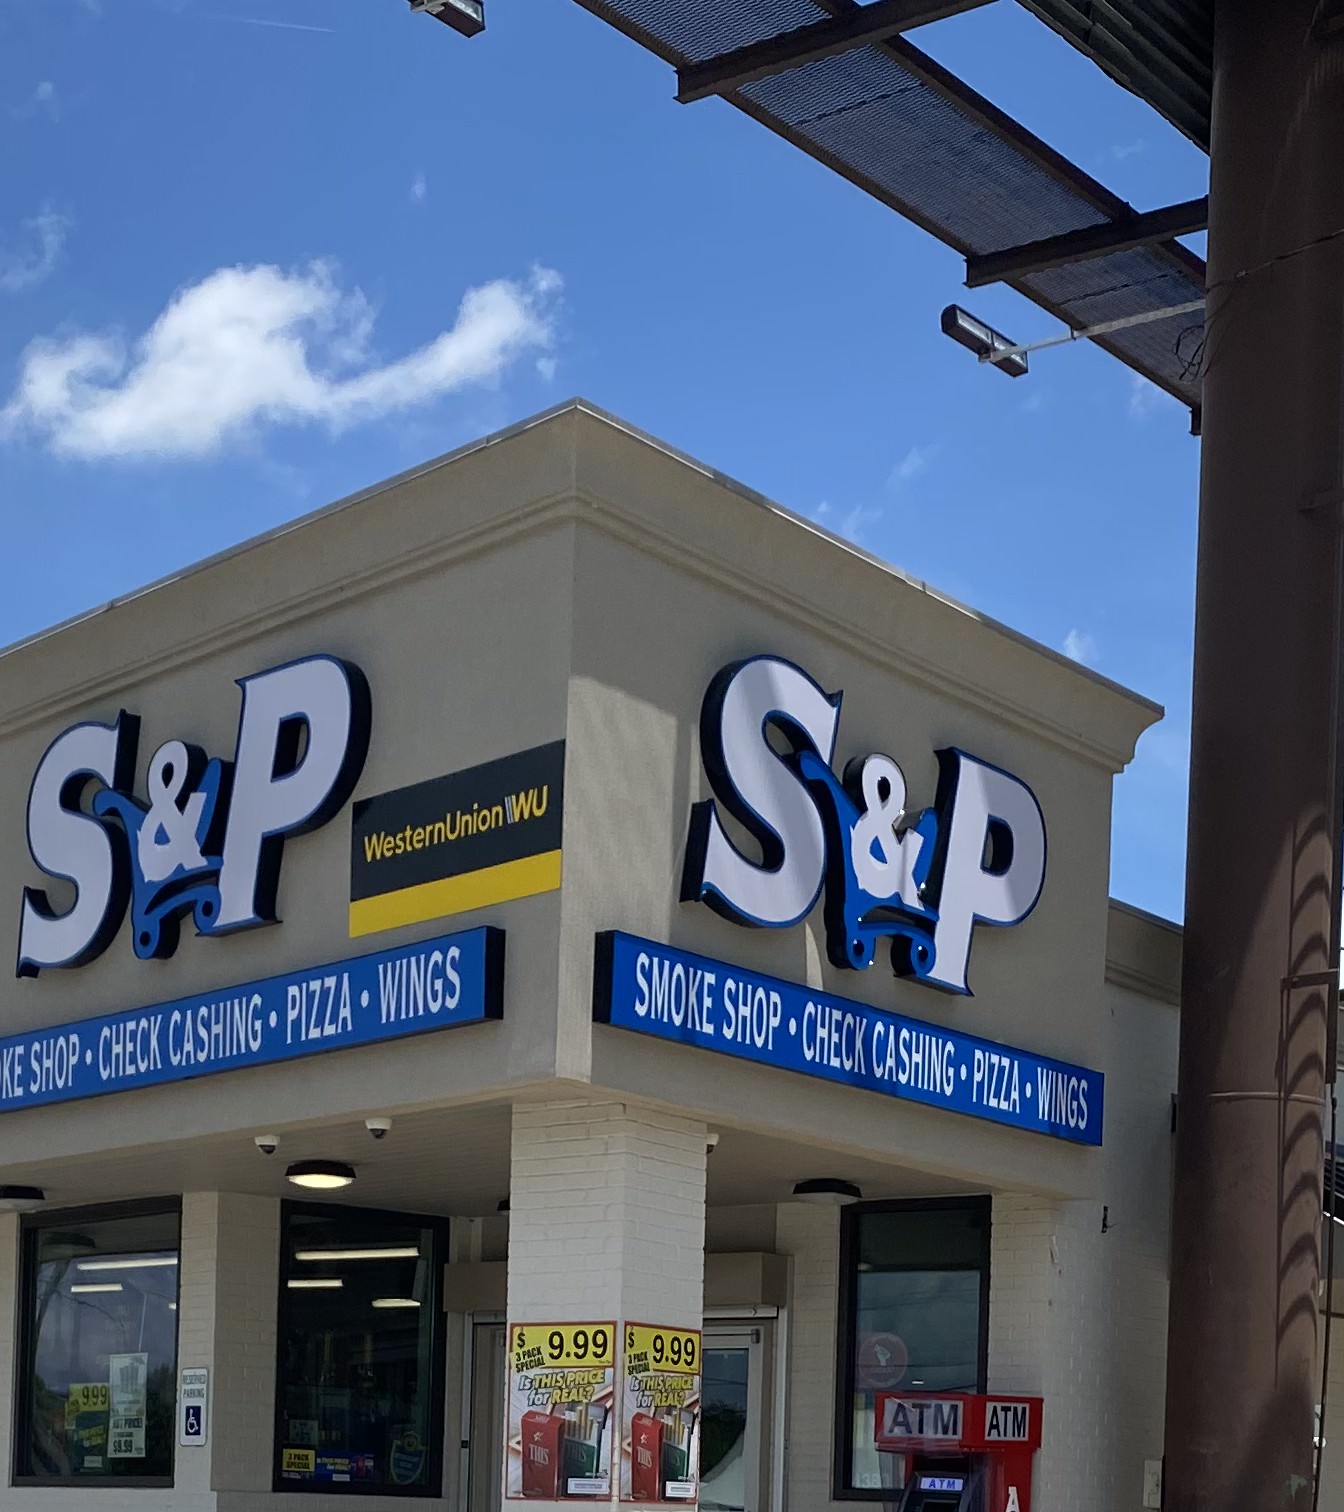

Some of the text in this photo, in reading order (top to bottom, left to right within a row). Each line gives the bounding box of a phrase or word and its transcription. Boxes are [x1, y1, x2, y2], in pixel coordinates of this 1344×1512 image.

[16, 653, 371, 977] S&P
[364, 785, 548, 862] WesternUnion WU
[680, 655, 1047, 996] S&P
[30, 1033, 79, 1092] SHOP
[98, 1014, 162, 1076] CHECK
[168, 994, 262, 1066] CASHING
[286, 973, 353, 1044] PIZZA
[378, 945, 461, 1024] WINGS
[634, 952, 1089, 1131] SMOKE SHOP CHECK CASHING PIZZA WINGS
[522, 1346, 543, 1360] PACK
[548, 1329, 608, 1360] 9.99
[652, 1334, 696, 1367] 9.99
[516, 1359, 546, 1374] SPECIAL
[633, 1351, 648, 1364] PACK
[532, 1370, 565, 1390] THIS
[565, 1368, 605, 1387] PRICE
[627, 1362, 650, 1376] SPECIAL
[640, 1375, 665, 1391] THIS
[664, 1375, 694, 1392] PRICE
[528, 1385, 595, 1407] for REAL?
[636, 1390, 686, 1408] for REAL?
[888, 1403, 958, 1436] ATM
[987, 1405, 1027, 1438] ATM
[528, 1443, 550, 1465] THIS
[928, 1479, 956, 1489] ATM
